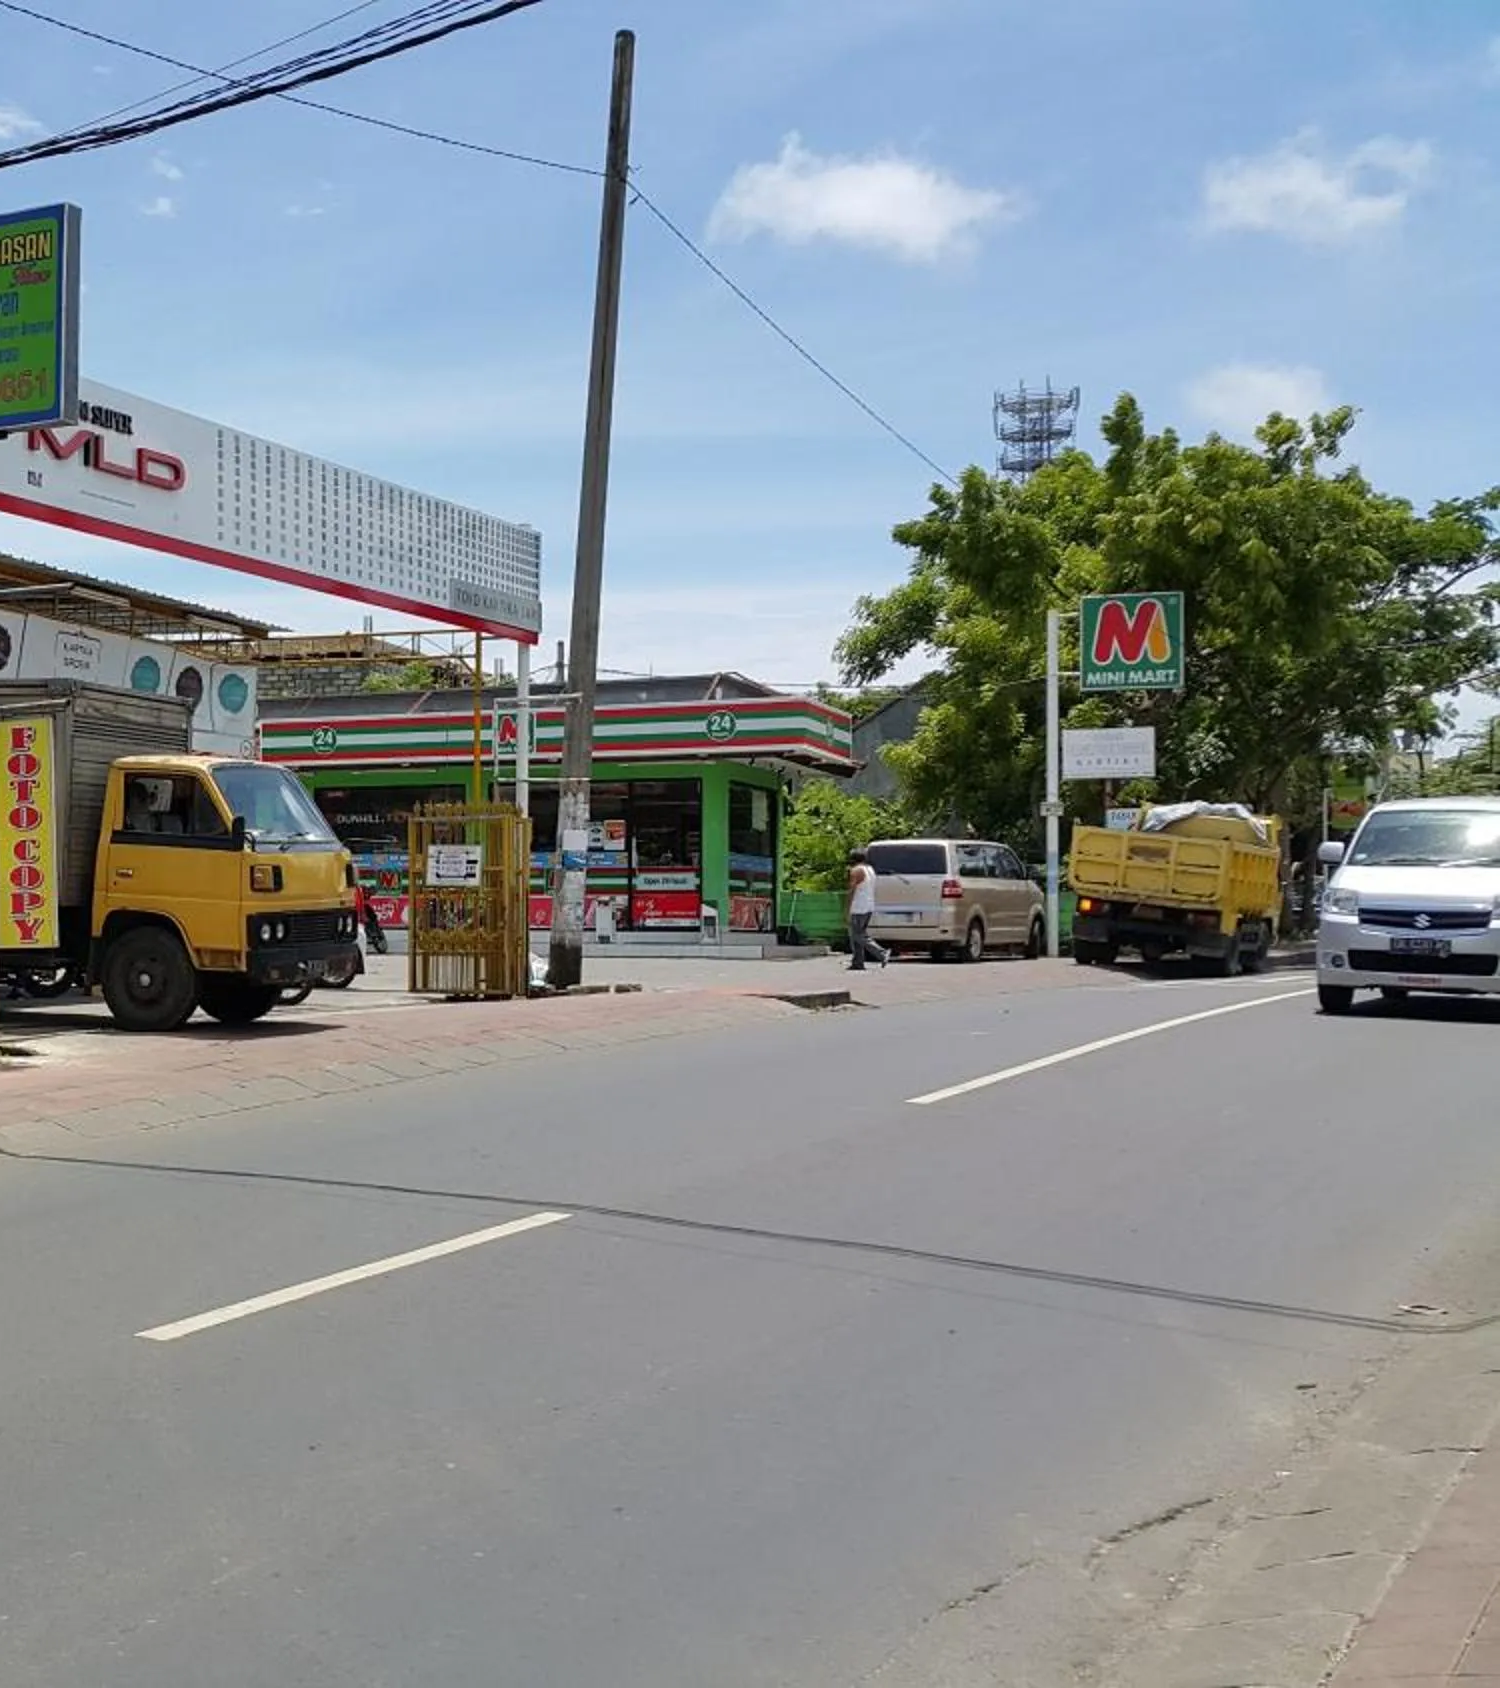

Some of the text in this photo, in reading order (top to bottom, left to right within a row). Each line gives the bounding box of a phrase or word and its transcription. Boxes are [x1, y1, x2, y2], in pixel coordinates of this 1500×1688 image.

[1085, 669, 1177, 685] MINI MART
[710, 715, 731, 731] 24
[315, 730, 334, 745] 24
